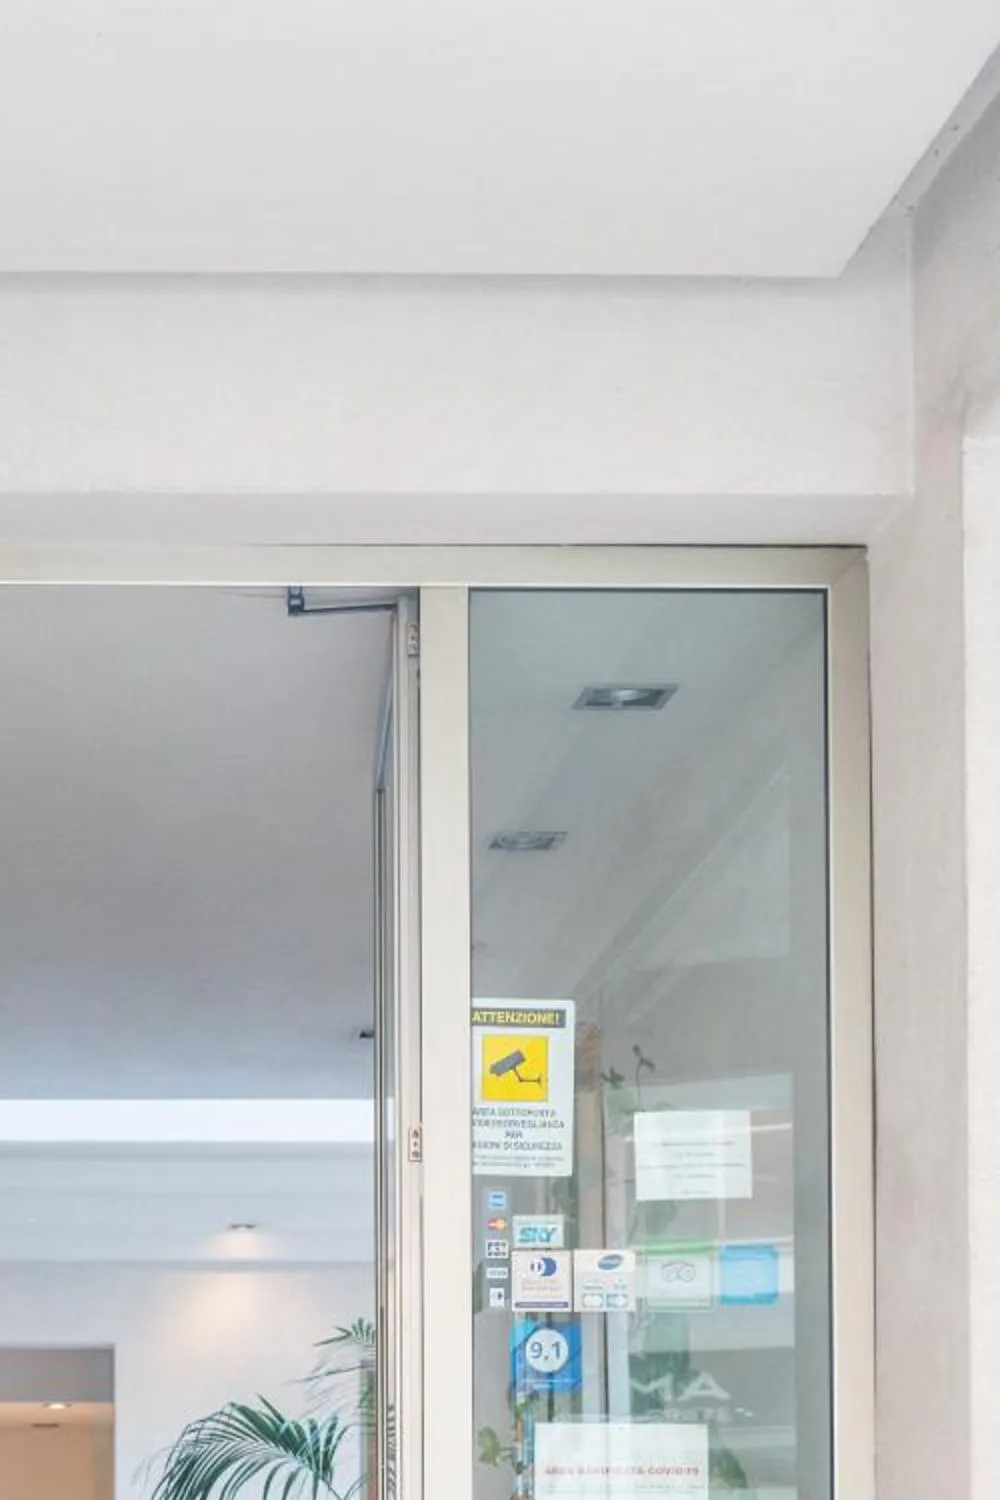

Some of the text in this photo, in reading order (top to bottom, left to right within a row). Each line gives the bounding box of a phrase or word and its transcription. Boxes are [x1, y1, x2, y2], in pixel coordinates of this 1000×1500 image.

[472, 1011, 560, 1025] ATTENZIONE!
[518, 1227, 557, 1243] SKY
[531, 1341, 562, 1361] 9,1
